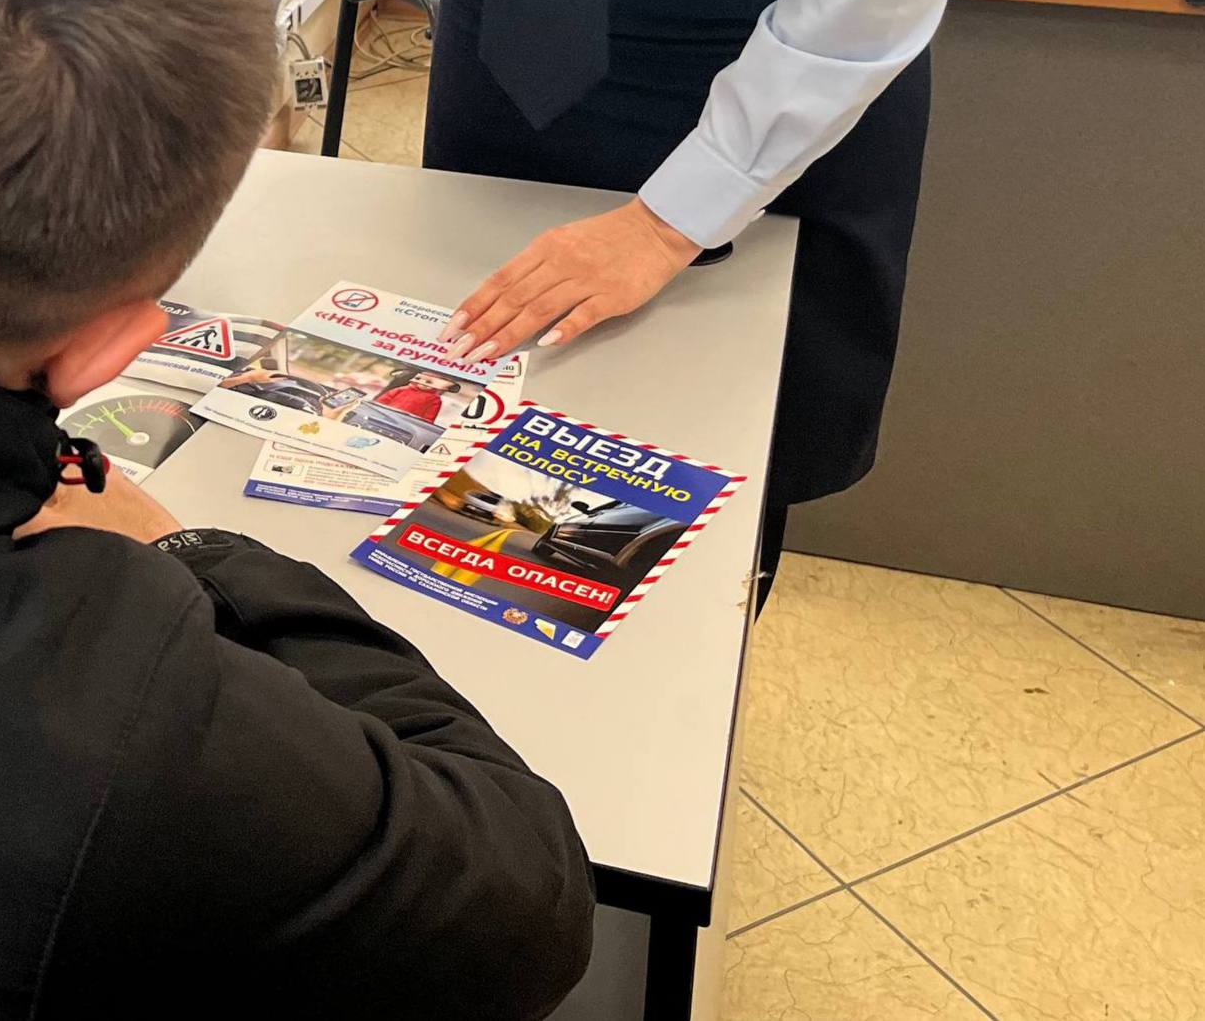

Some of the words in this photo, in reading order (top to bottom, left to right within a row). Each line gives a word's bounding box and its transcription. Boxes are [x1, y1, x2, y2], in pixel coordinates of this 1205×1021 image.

[314, 311, 371, 331] «НЕТ
[372, 339, 395, 352] за
[397, 342, 487, 377] рулем!»
[498, 443, 597, 485] ПОЛОСУ
[511, 432, 542, 451] НА
[551, 449, 691, 502] ВСТРЕЧНУЮ
[522, 415, 672, 481] ВЫЕЗД
[406, 531, 494, 571] ВСЕГДА
[507, 565, 613, 604] ОПАСЕН!
